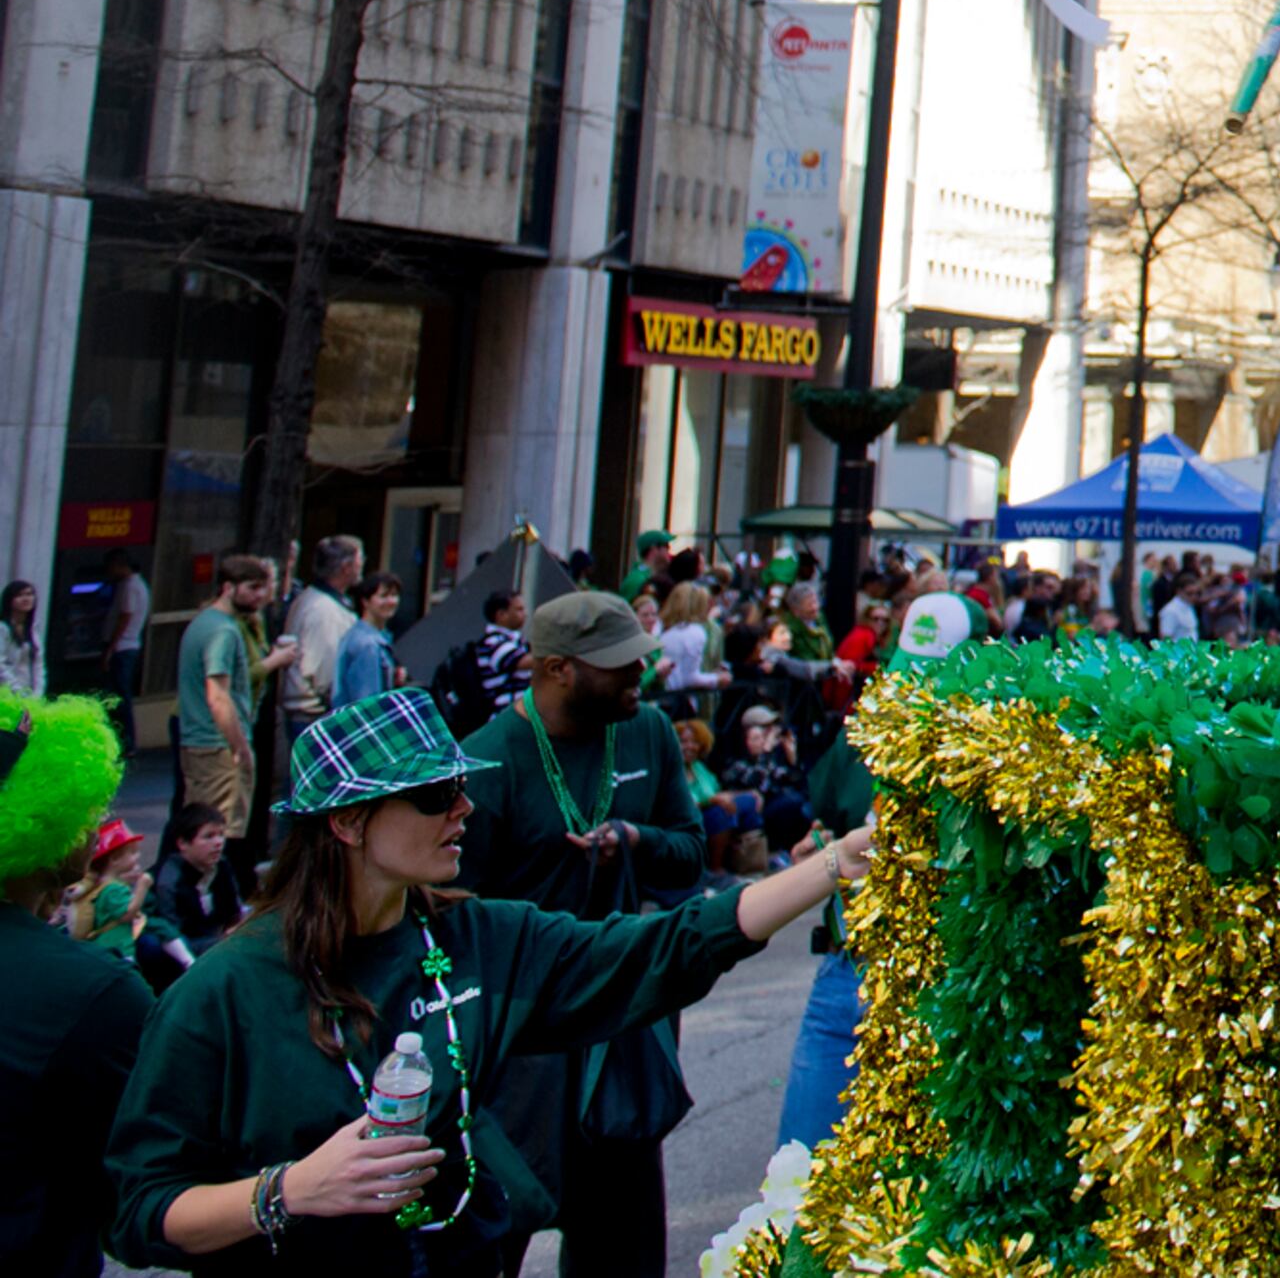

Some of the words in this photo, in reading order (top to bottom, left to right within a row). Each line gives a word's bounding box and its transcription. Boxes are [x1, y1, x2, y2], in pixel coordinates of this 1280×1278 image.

[641, 310, 736, 359] WELLS
[739, 321, 821, 367] FARGO
[1015, 516, 1243, 541] www.971teriver.com
[425, 986, 481, 1014] Oldastle
